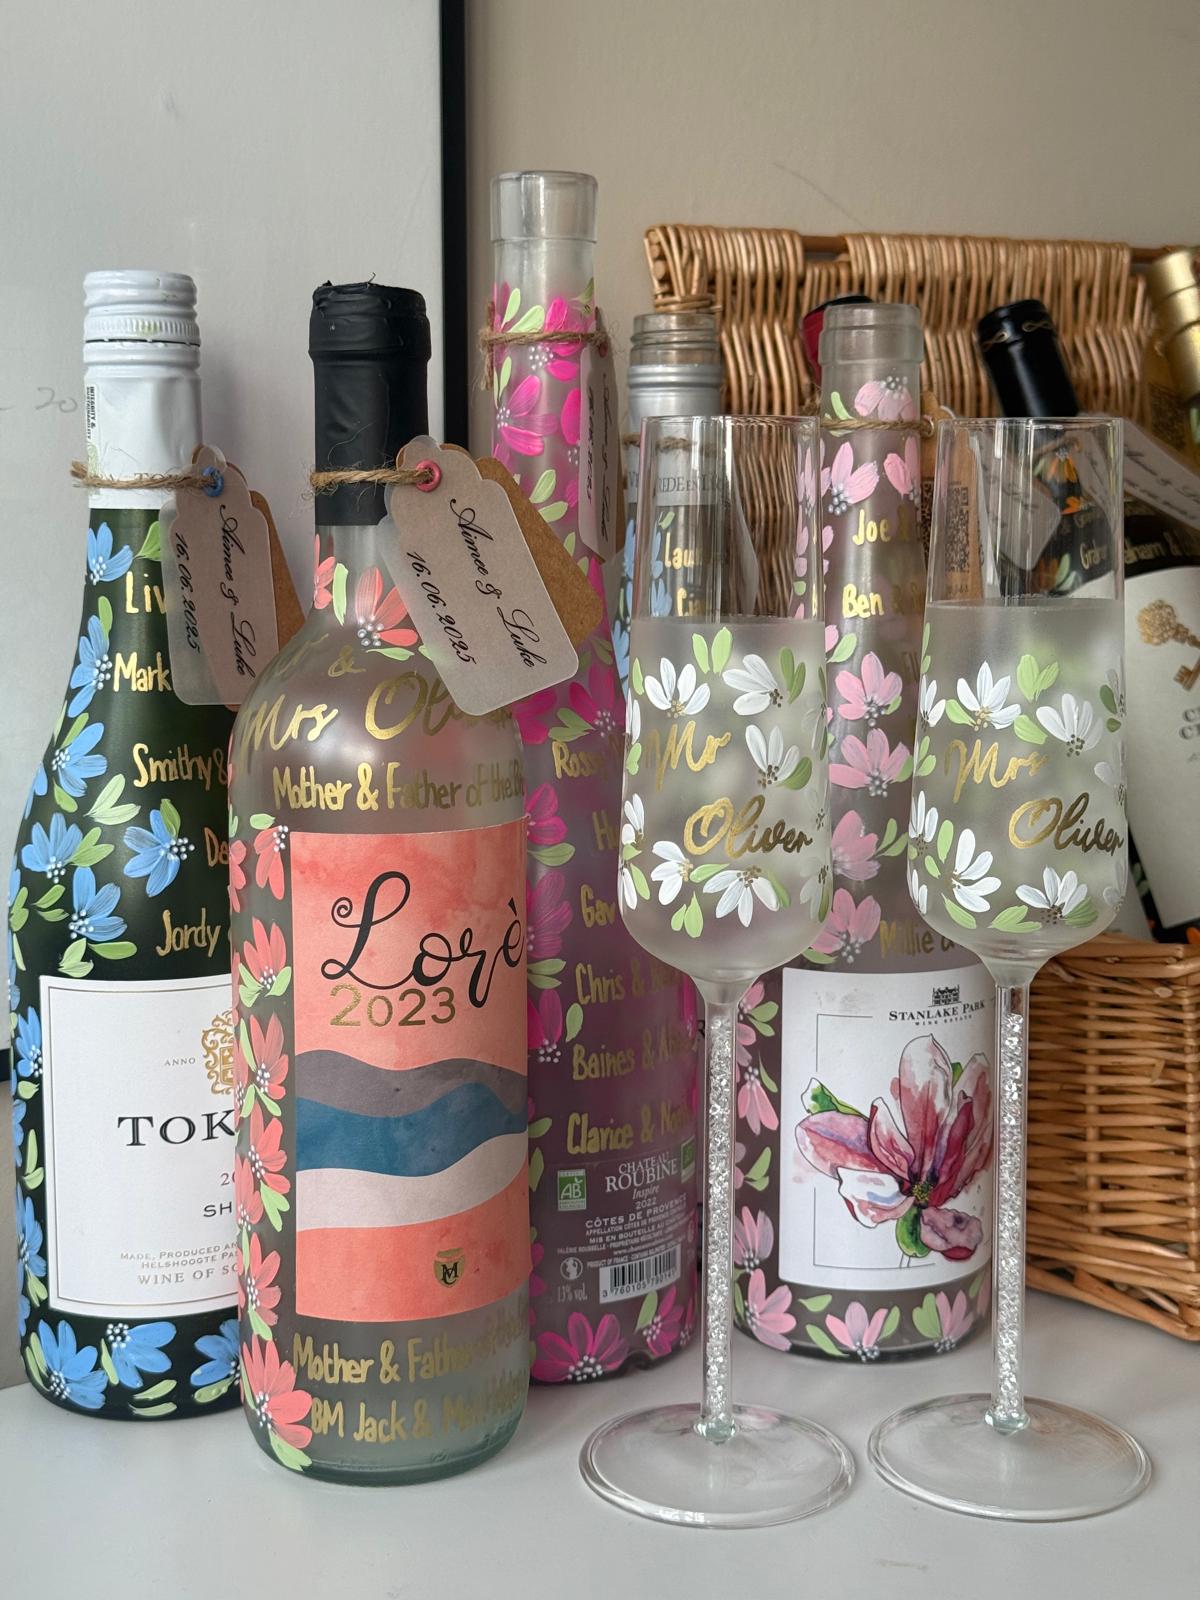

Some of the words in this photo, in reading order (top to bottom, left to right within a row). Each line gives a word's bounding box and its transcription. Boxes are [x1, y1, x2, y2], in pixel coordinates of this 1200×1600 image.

[852, 509, 891, 546] Joe
[449, 498, 494, 576] Aimee
[496, 606, 548, 668] Luke
[842, 583, 885, 619] Ben
[230, 611, 256, 678] Luke
[113, 651, 172, 693] Mark
[239, 694, 339, 770] Mrs
[645, 720, 732, 792] Mr
[944, 738, 1049, 803] Mrs
[272, 766, 353, 810] Mother
[356, 762, 379, 811] &
[386, 761, 462, 810] Father
[156, 907, 222, 958] Jordy
[575, 961, 628, 1005] Chris
[329, 982, 456, 1027] 2023
[888, 1006, 959, 1021] STANLAKE
[962, 1000, 985, 1015] PARK
[164, 1057, 196, 1067] ANNO
[572, 1044, 635, 1081] Baines
[117, 1109, 236, 1147] TOK
[605, 1158, 678, 1193] ROUBINE
[618, 1151, 669, 1175] CHATEAU
[203, 1201, 233, 1218] SH
[560, 1182, 582, 1200] AB
[635, 1196, 658, 1211] 2022
[585, 1216, 625, 1229] CÔTES
[628, 1211, 642, 1221] DE
[589, 1235, 604, 1244] MIS
[618, 1225, 656, 1240] BOUTEILLE
[120, 1251, 156, 1261] MADE,
[159, 1244, 221, 1259] PRODUCED
[141, 1254, 217, 1270] HELSHOOGTE
[137, 1271, 185, 1286] WINE
[192, 1267, 215, 1281] OF
[291, 1332, 375, 1384] Mother
[379, 1339, 401, 1385] &
[353, 1399, 410, 1443] Jack
